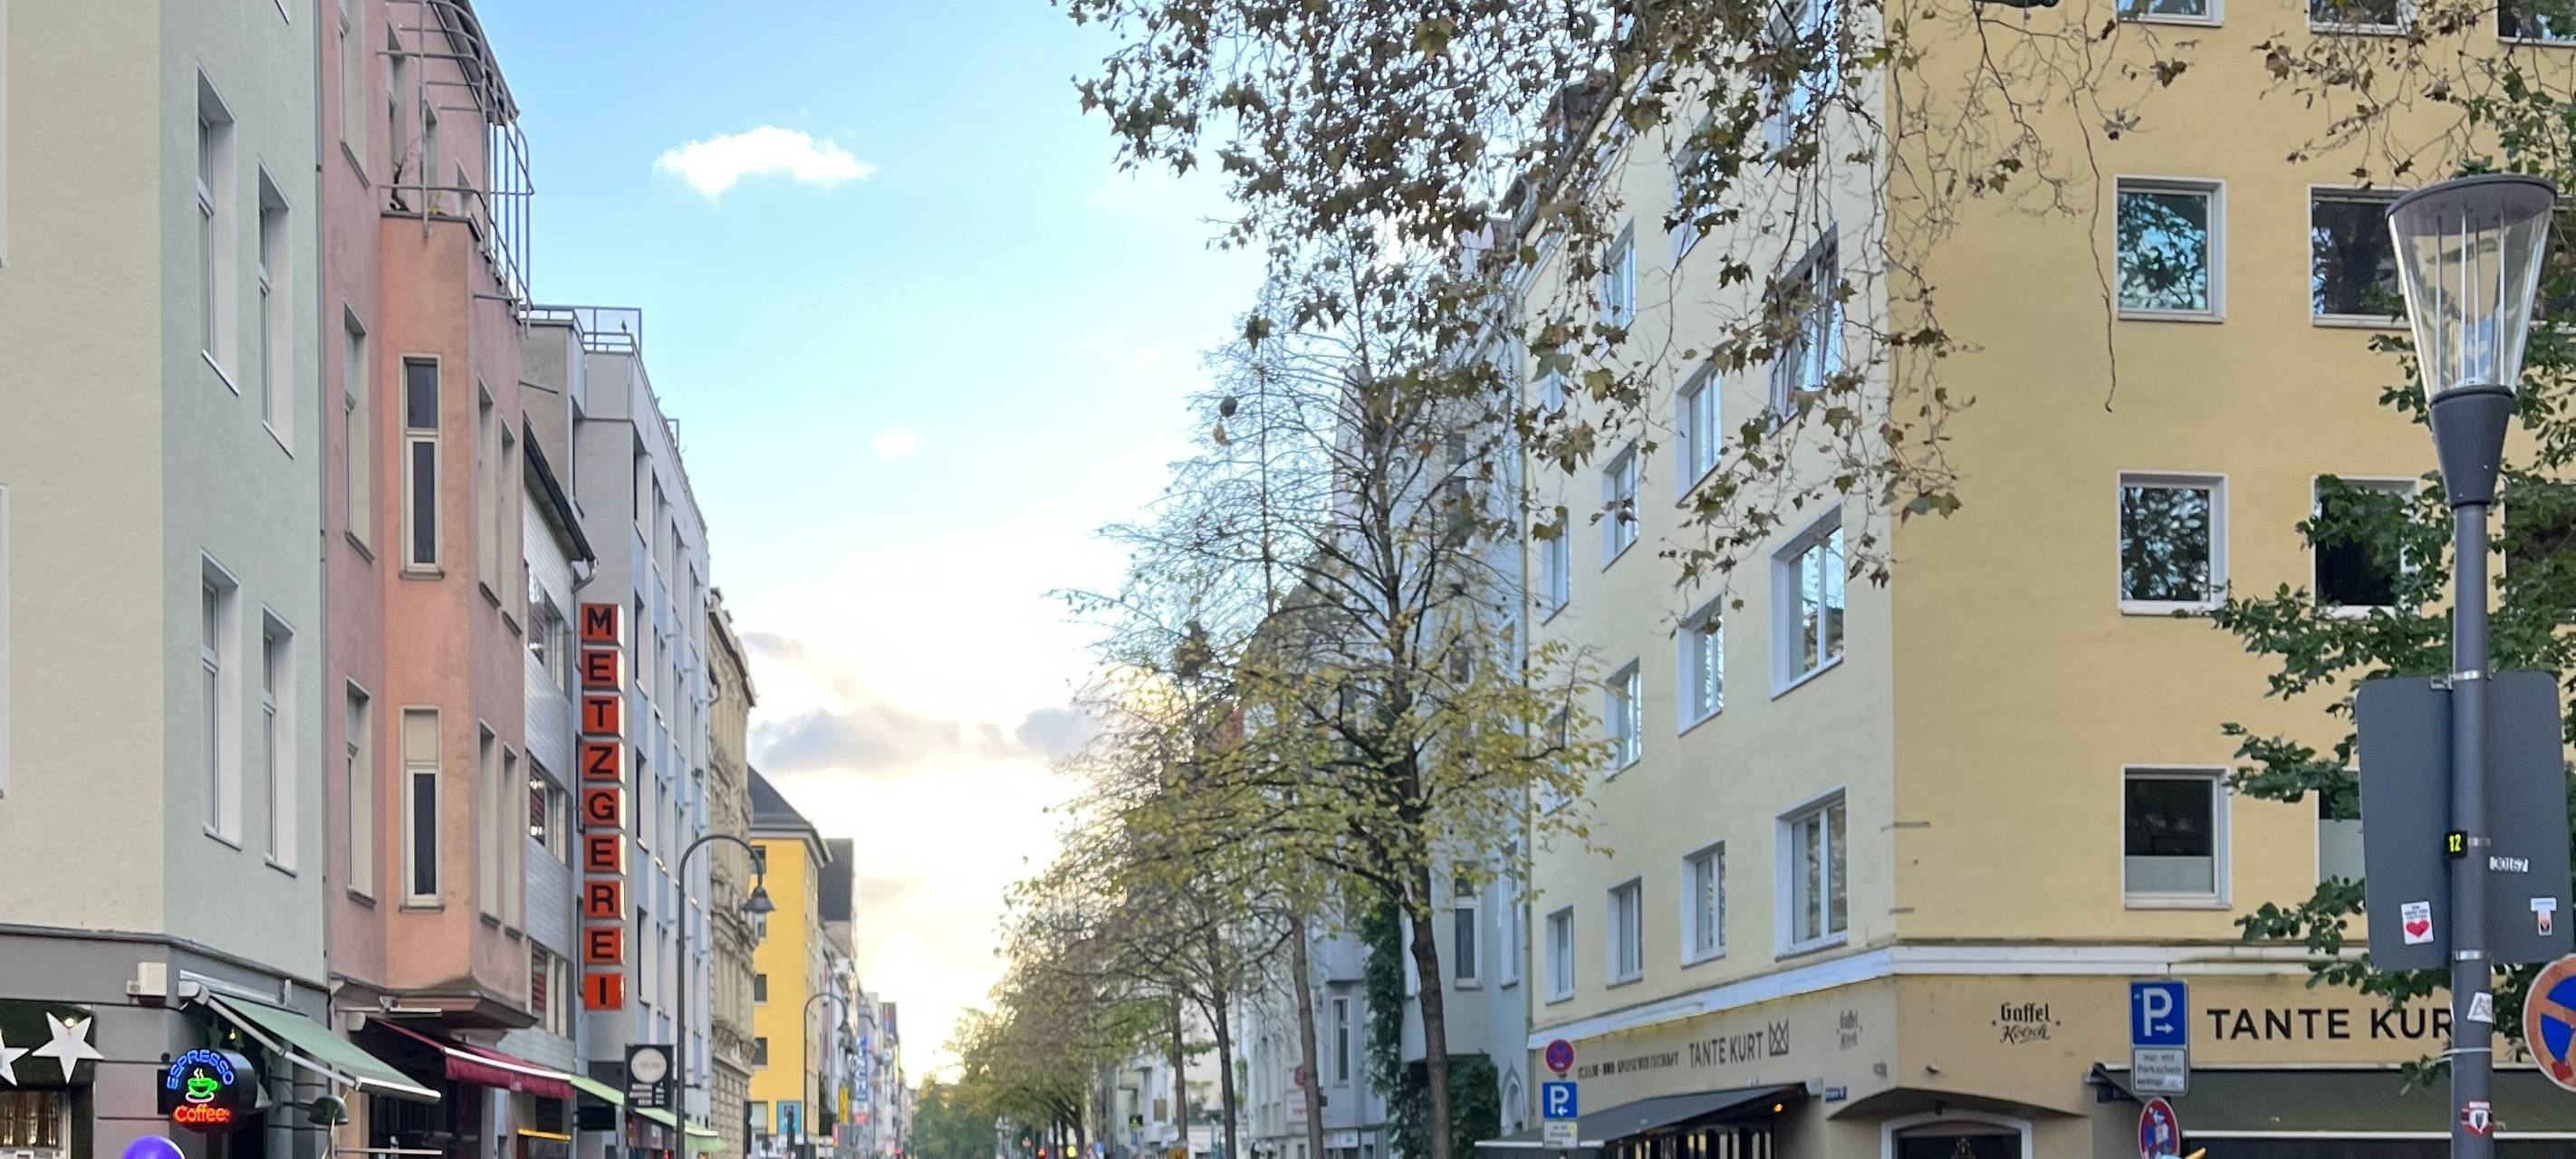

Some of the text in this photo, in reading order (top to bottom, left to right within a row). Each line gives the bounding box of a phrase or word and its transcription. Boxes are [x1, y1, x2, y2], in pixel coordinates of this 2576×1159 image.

[587, 607, 614, 1006] METZGEREI
[2448, 834, 2462, 852] 12
[2001, 1001, 2051, 1023] Gaffel
[2143, 988, 2173, 1037] P
[2206, 1008, 2350, 1040] TANTE
[2370, 1007, 2453, 1039] KUR
[1688, 1037, 1726, 1069] TANTE
[1729, 1030, 1764, 1064] KURT
[166, 1049, 235, 1090] ESPRESSO
[174, 1103, 228, 1123] Coffee
[1550, 1085, 1570, 1116] P
